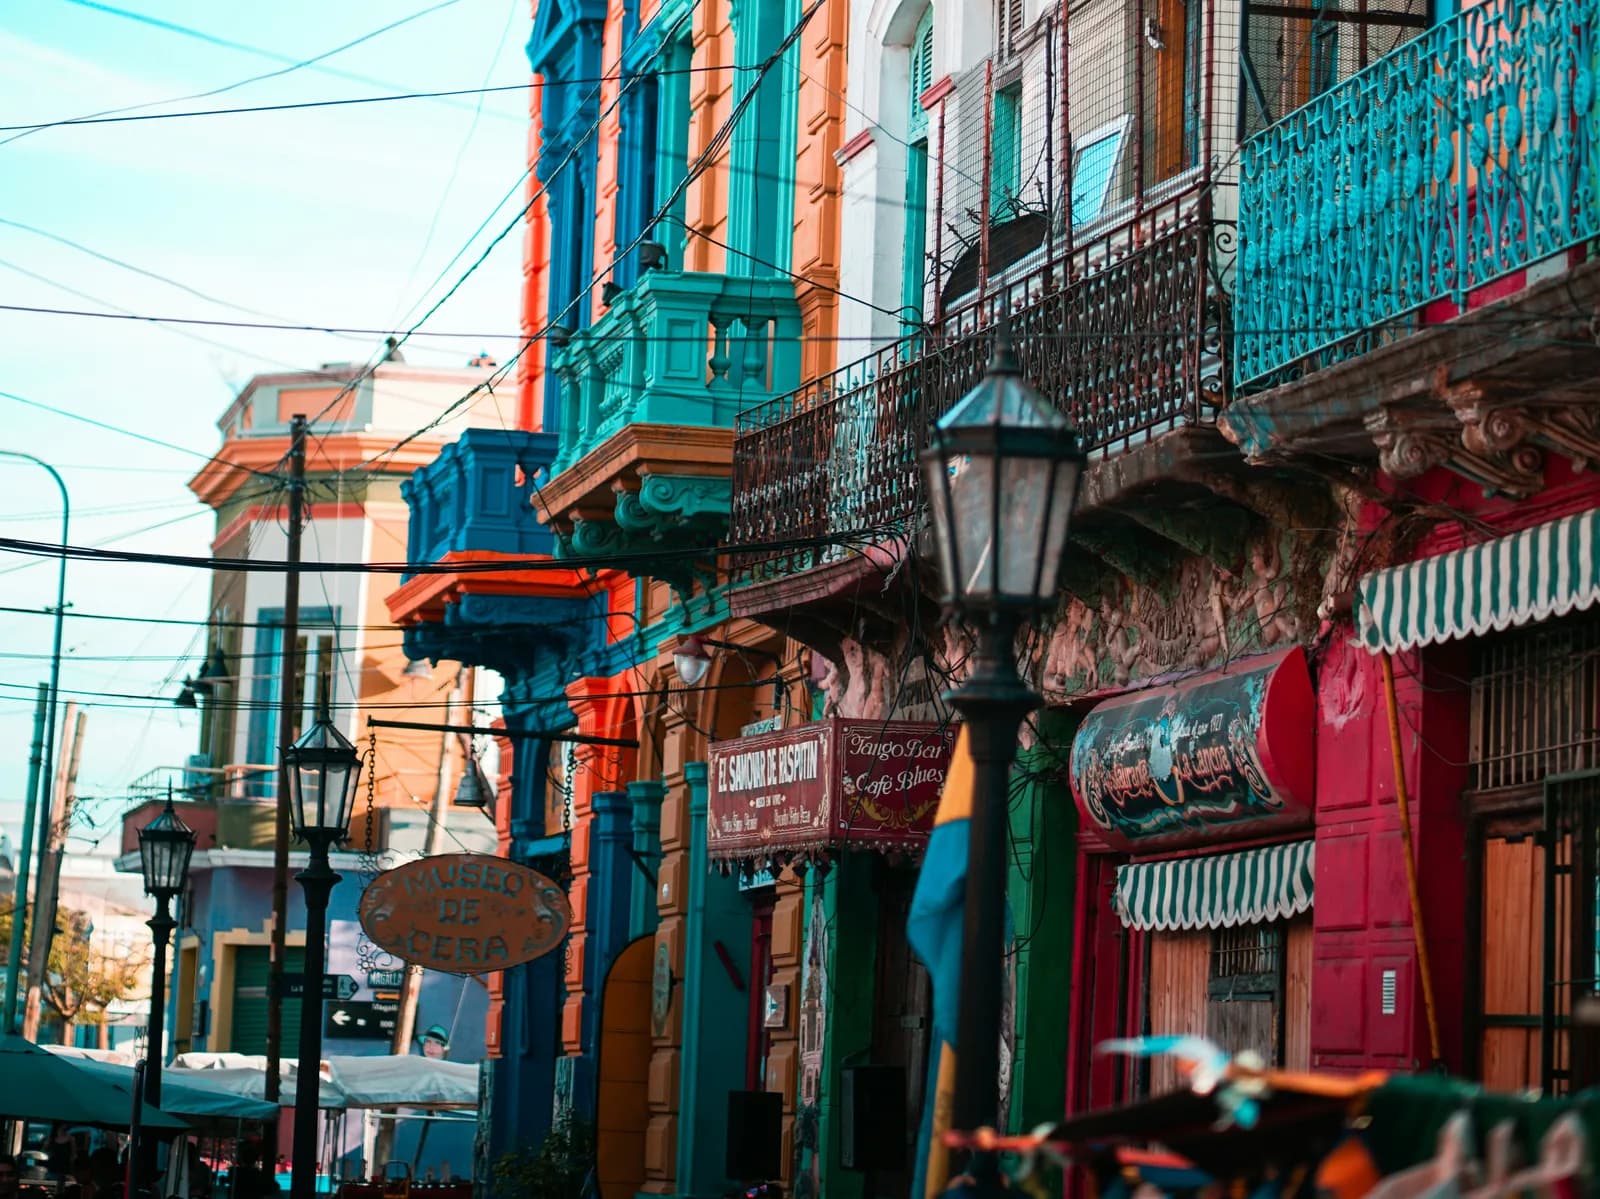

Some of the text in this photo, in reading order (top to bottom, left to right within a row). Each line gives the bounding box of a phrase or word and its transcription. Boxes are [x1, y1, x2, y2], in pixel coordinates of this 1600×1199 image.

[850, 733, 941, 760] Tango Bar
[718, 740, 818, 792] EL SAMOVAR DE RASPUTIN
[856, 765, 945, 798] Café Blues
[403, 863, 524, 898] MUSEO
[439, 898, 480, 924] DE
[406, 925, 508, 963] CERA
